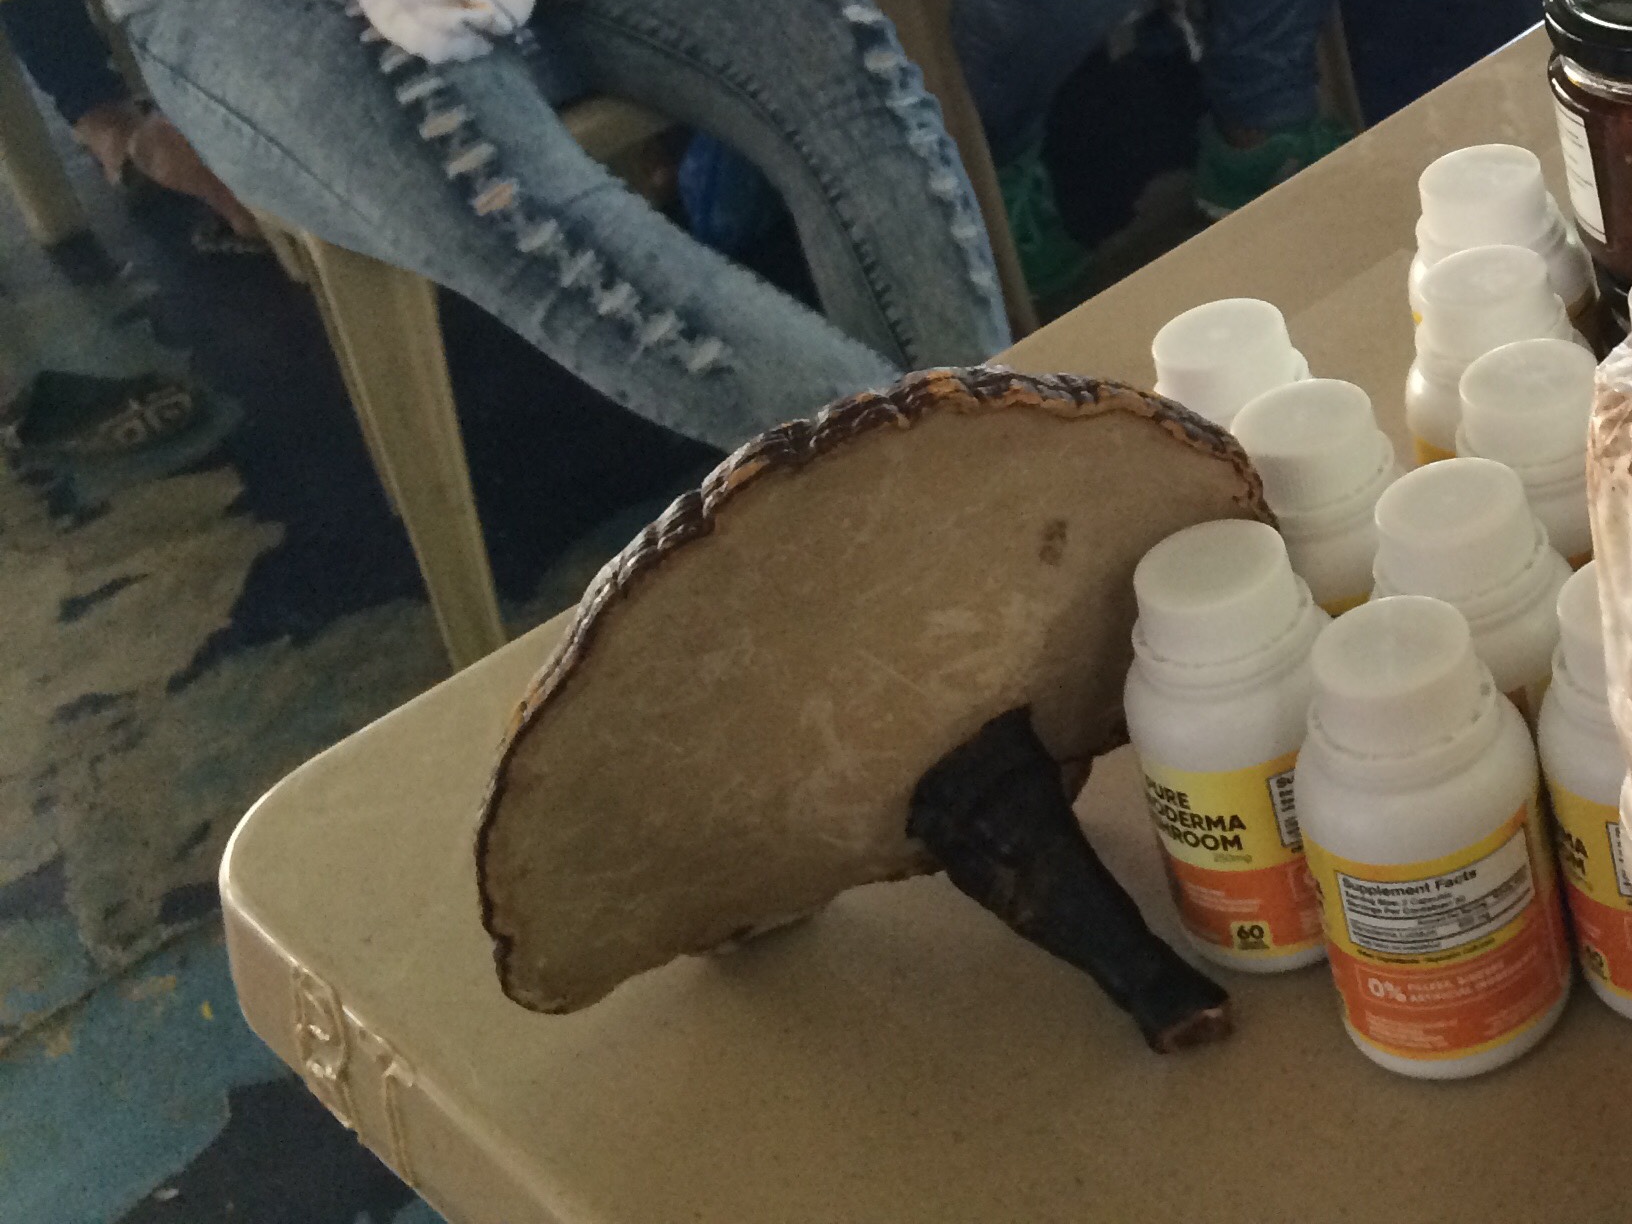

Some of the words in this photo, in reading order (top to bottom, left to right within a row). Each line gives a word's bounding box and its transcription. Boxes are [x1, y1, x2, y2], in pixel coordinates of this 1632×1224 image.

[1148, 794, 1246, 833] ODERMA
[1342, 876, 1430, 897] Supplement
[1435, 869, 1477, 891] Facts
[1237, 924, 1264, 940] 60
[1367, 977, 1406, 1003] 0%
